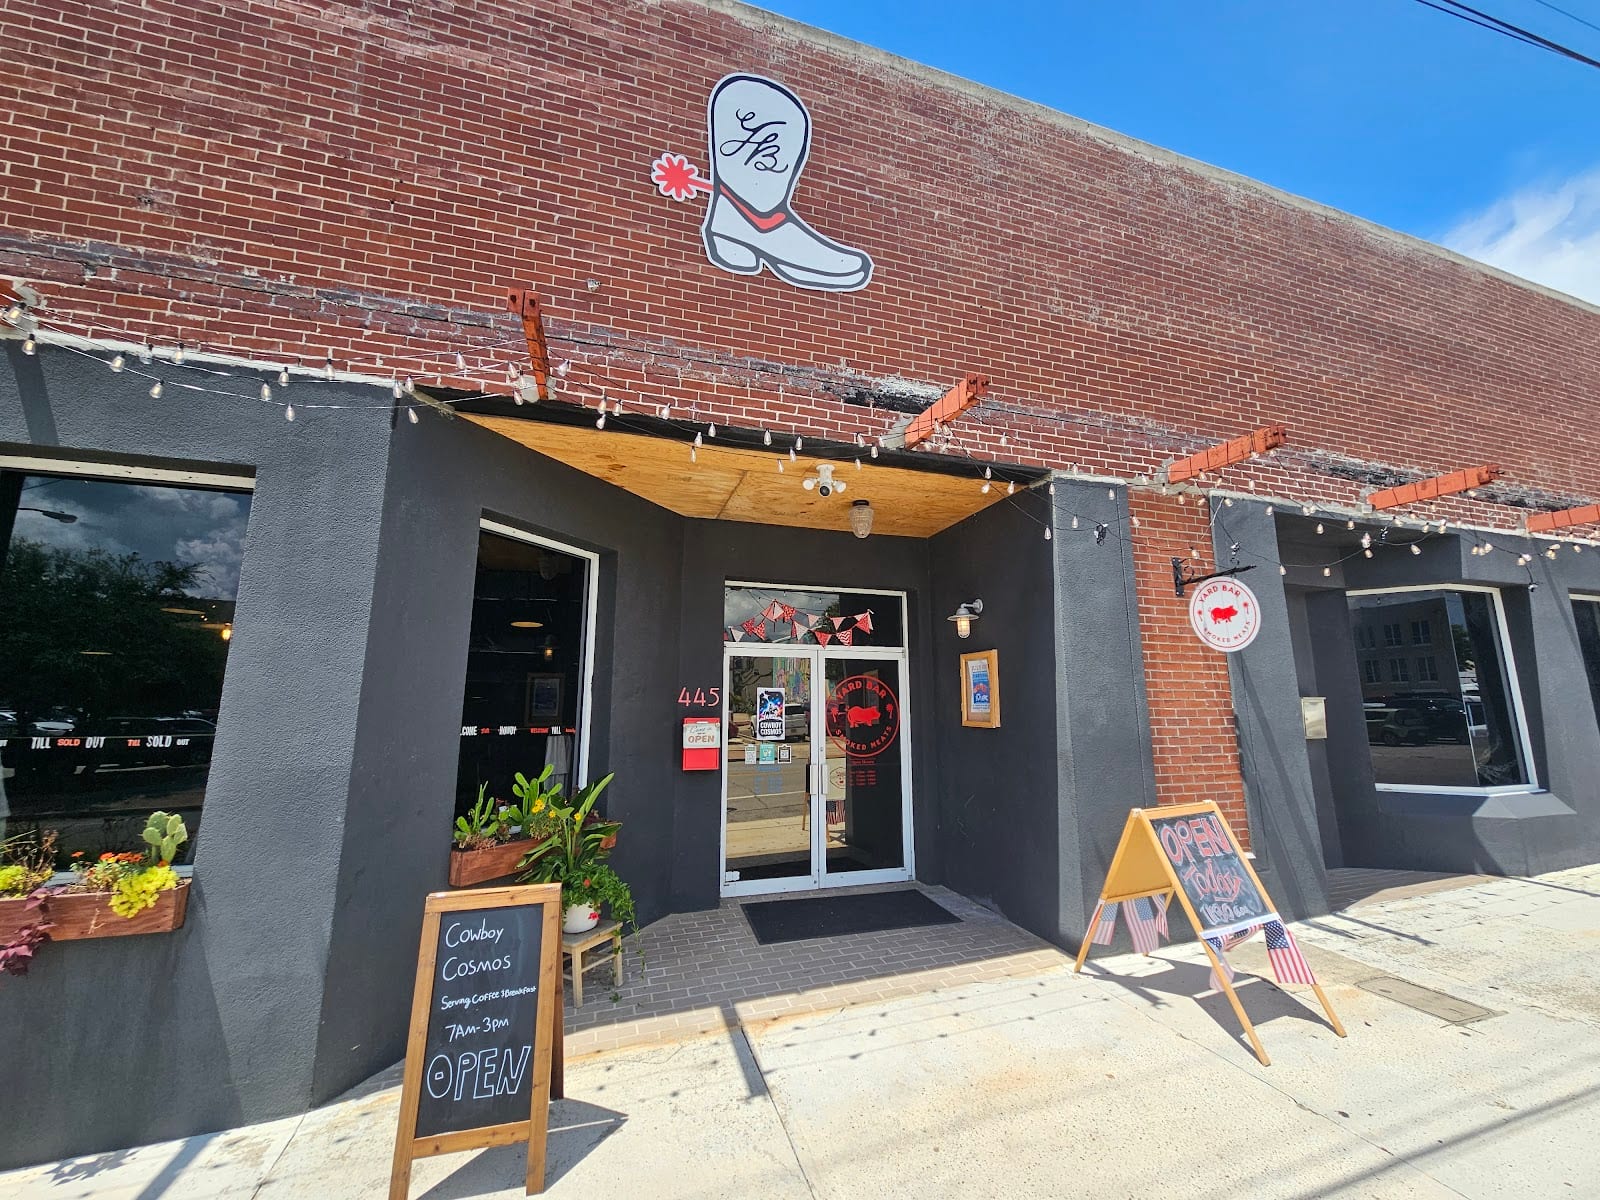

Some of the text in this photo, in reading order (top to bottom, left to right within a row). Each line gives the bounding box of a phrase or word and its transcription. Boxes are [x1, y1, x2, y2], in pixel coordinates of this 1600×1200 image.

[1199, 584, 1241, 602] YARD BAR
[677, 687, 720, 707] 445
[836, 680, 887, 700] YARD BAR
[760, 721, 782, 729] COWBOY
[760, 728, 782, 736] COSMOS
[31, 736, 105, 749] TILL SOLD OUT
[127, 735, 190, 748] TILL SOLD OUT
[688, 735, 715, 744] OPEN
[835, 726, 892, 751] SMOKED MEATS
[1160, 815, 1233, 866] OPEN
[1184, 858, 1242, 902] Today
[445, 917, 504, 948] Cowboy
[427, 1045, 531, 1101] OPEN
